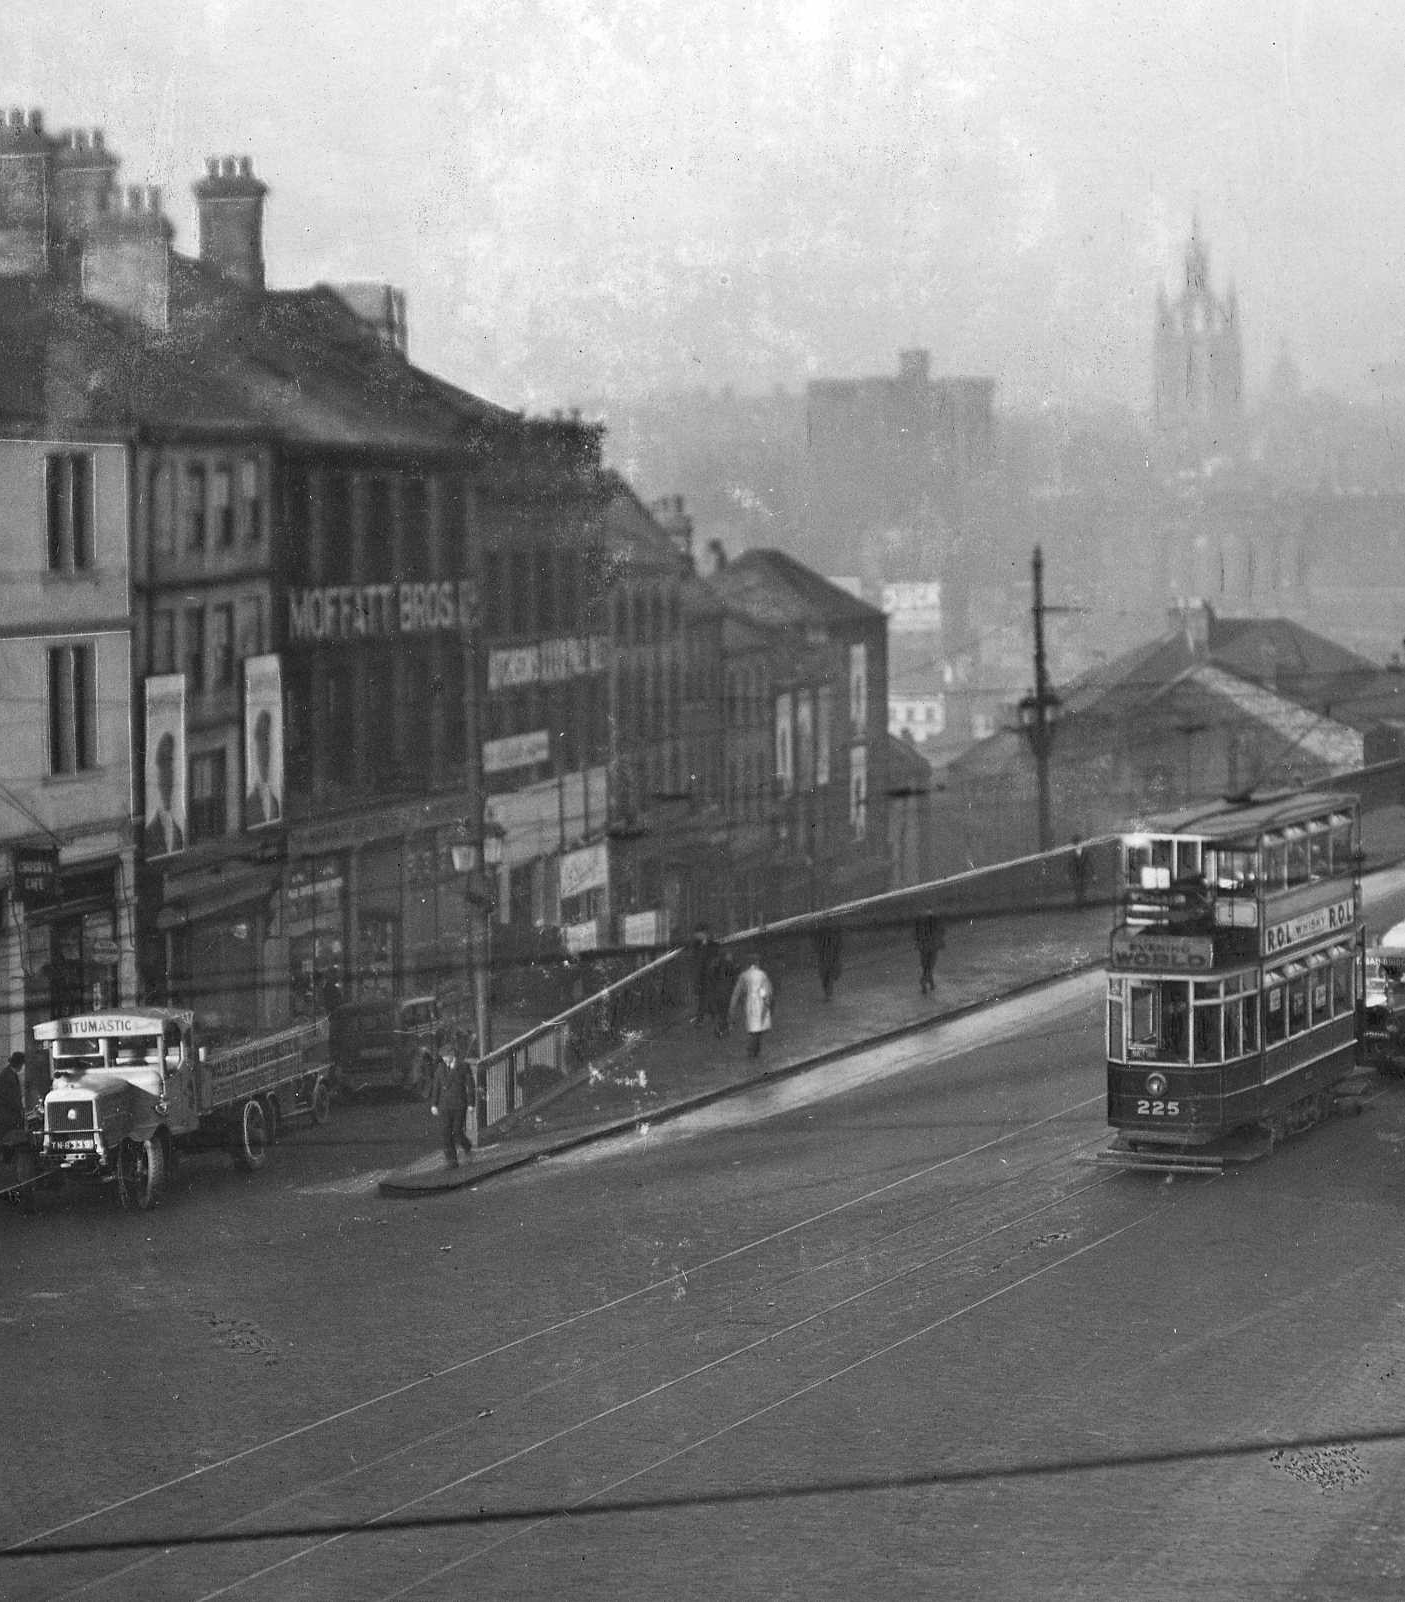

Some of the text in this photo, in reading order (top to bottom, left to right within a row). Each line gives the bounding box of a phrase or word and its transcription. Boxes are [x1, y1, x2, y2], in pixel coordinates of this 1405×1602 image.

[288, 587, 392, 639] MOFFATT
[1116, 952, 1207, 966] WORLD
[61, 1020, 132, 1034] BITUMASTIC
[1137, 1100, 1180, 1116] 225
